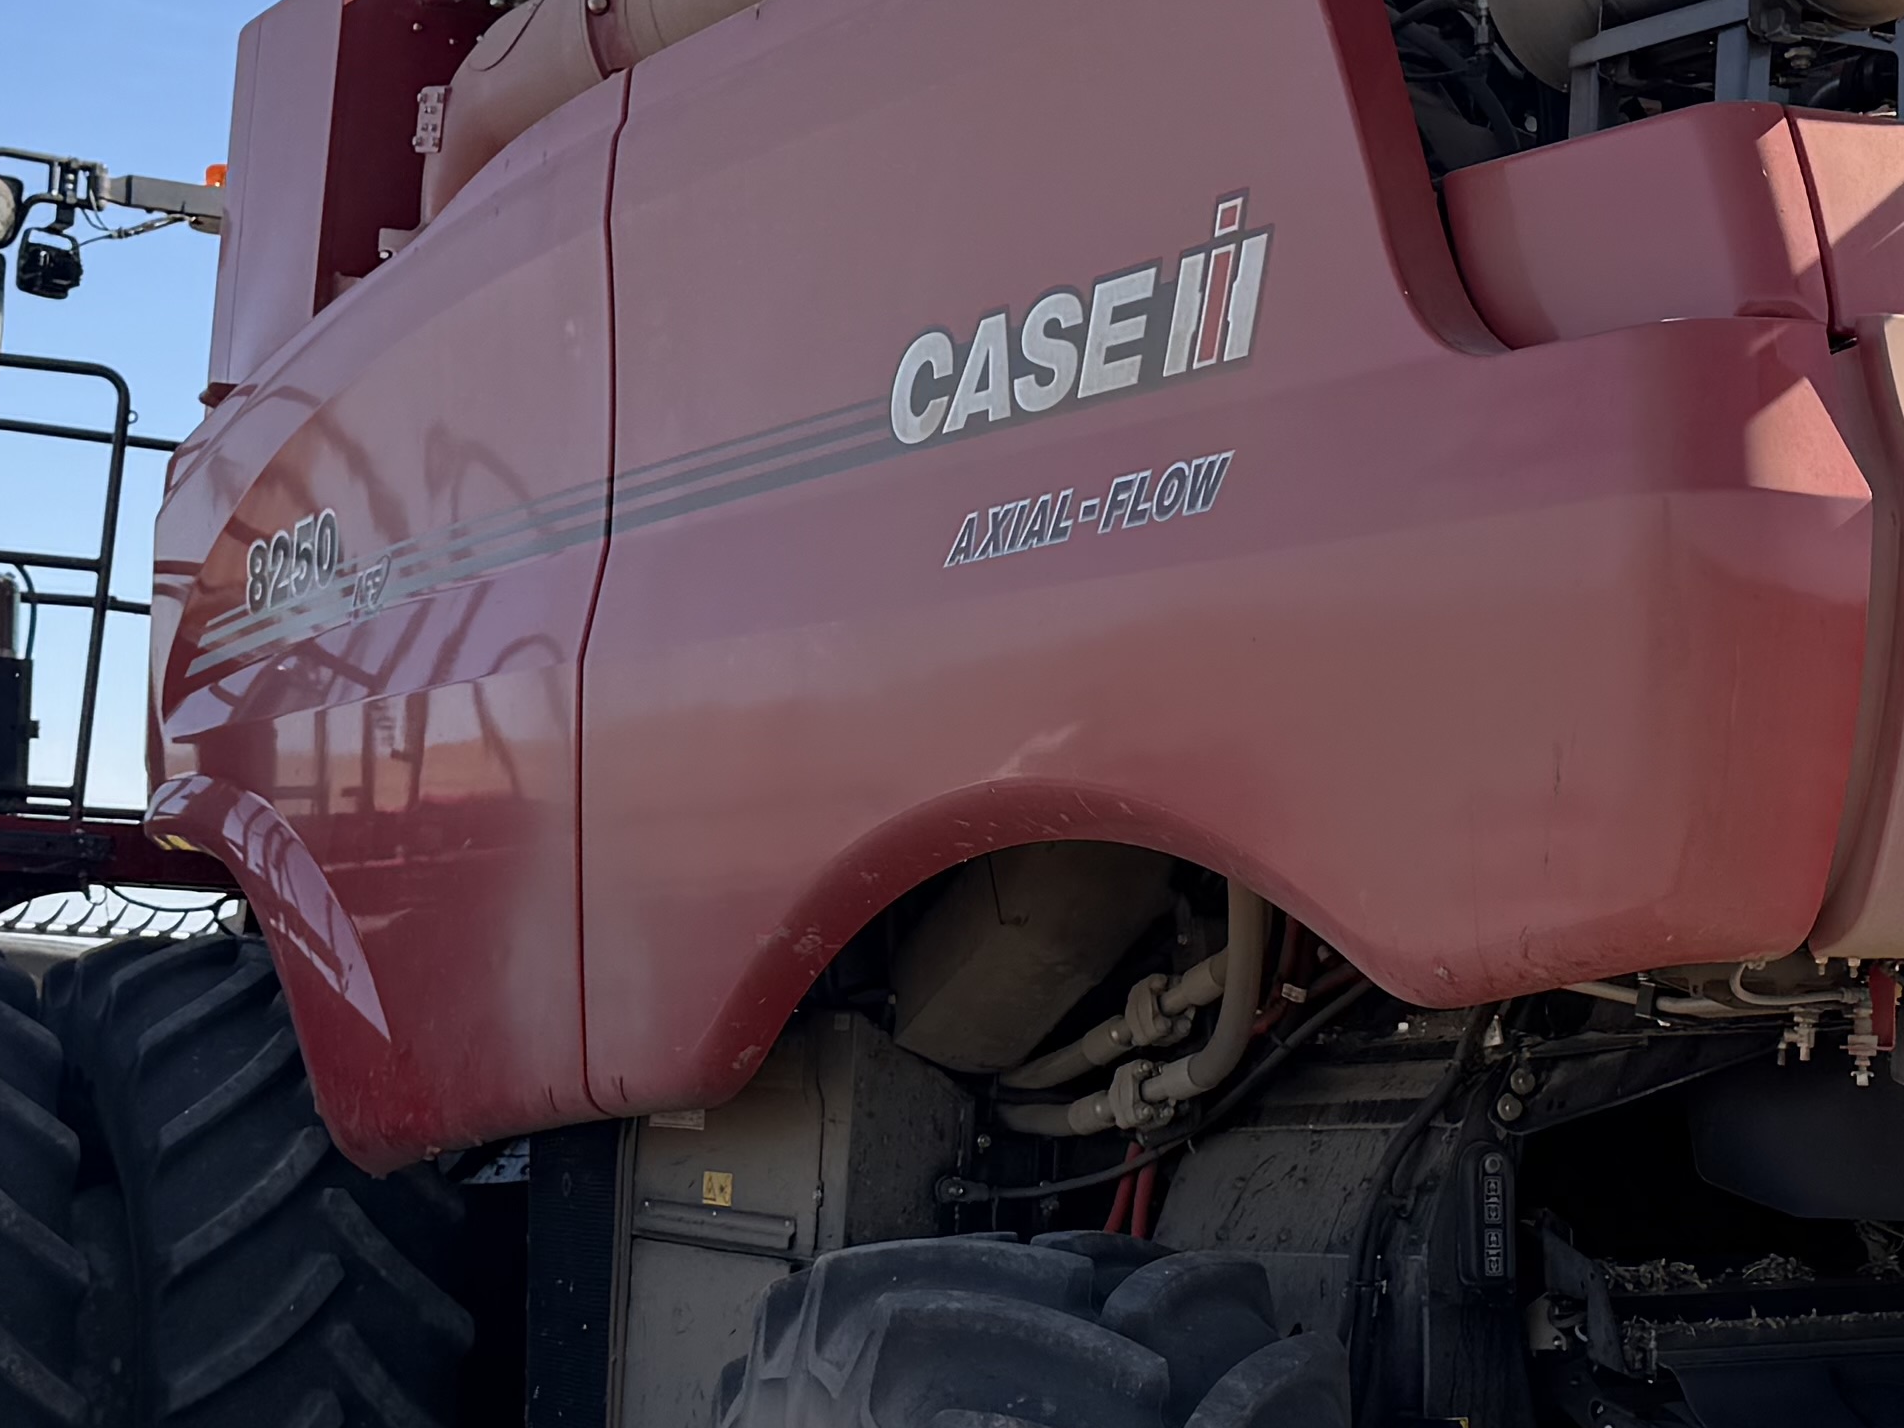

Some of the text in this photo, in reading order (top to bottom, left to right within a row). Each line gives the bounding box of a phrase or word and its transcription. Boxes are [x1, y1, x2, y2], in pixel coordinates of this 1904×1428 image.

[891, 266, 1158, 445] CASE
[246, 507, 339, 615] 8250
[943, 450, 1236, 569] AXIAL-FLOW
